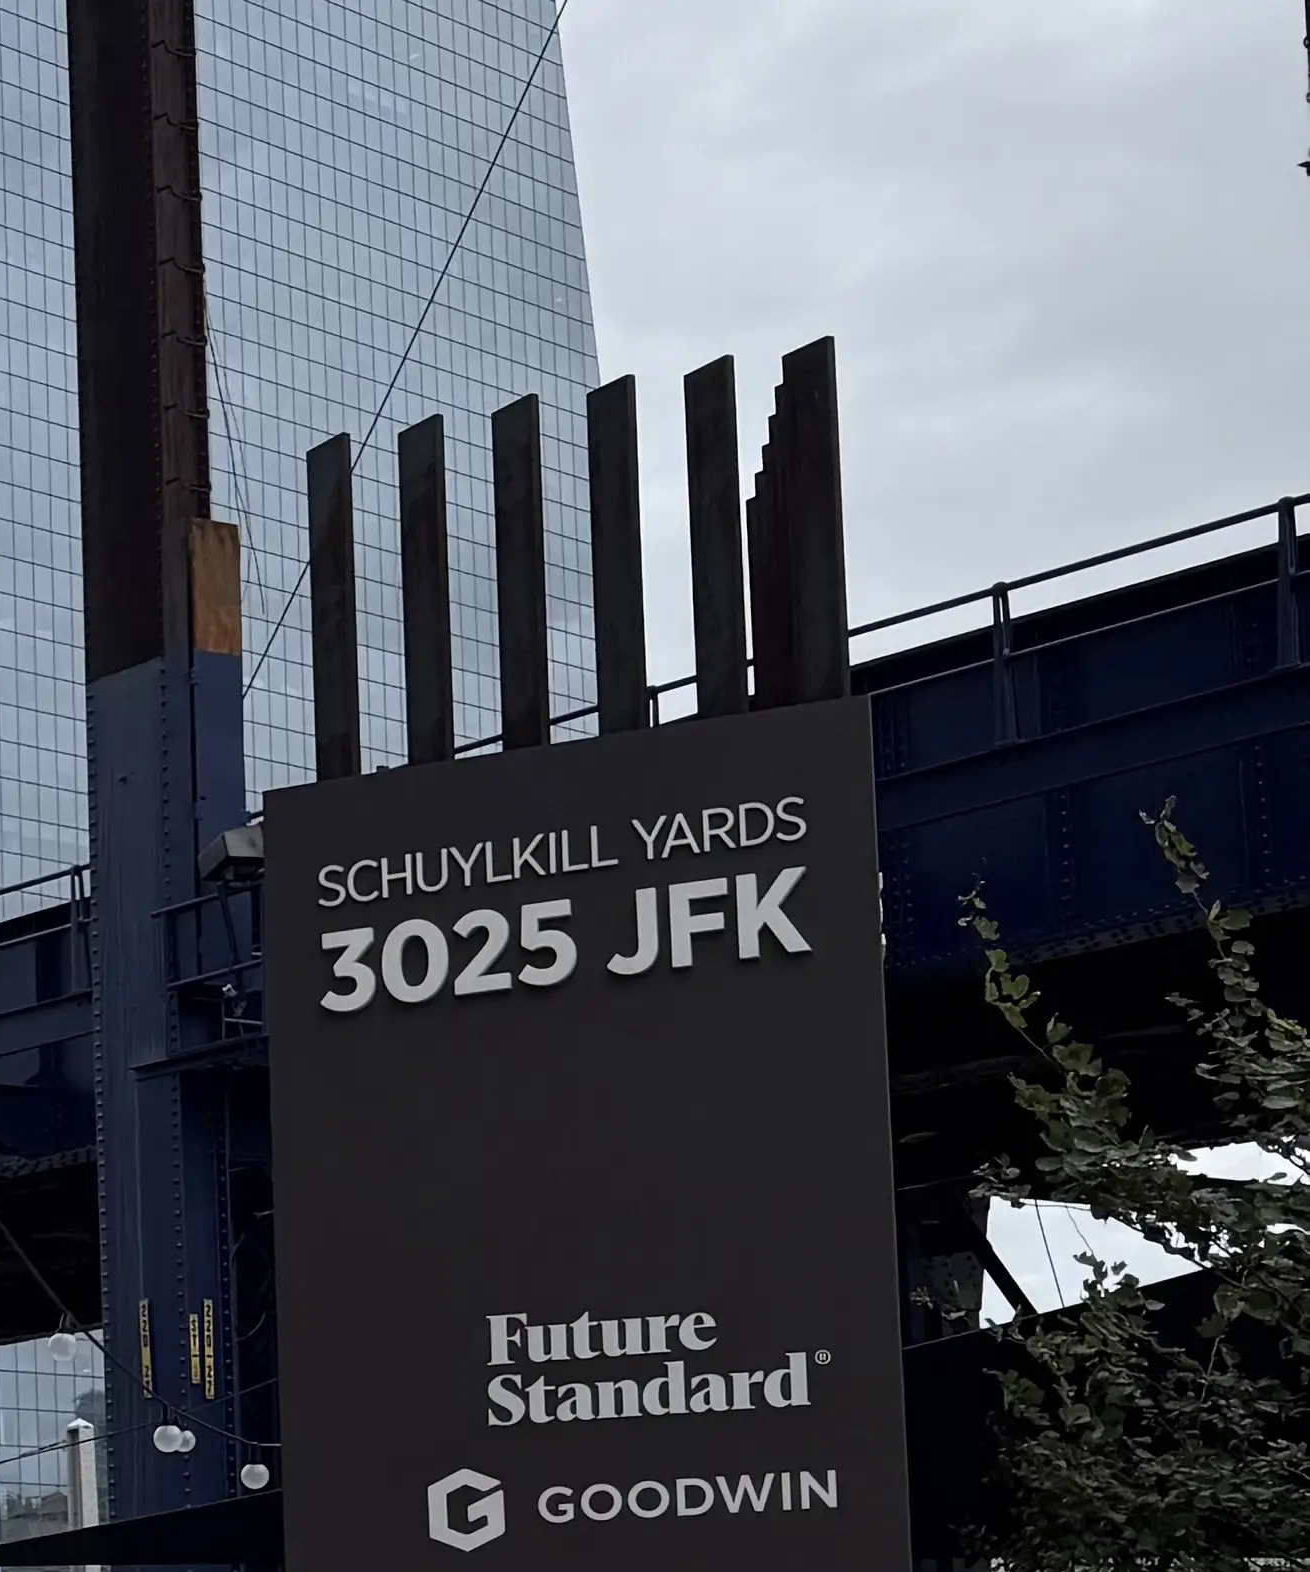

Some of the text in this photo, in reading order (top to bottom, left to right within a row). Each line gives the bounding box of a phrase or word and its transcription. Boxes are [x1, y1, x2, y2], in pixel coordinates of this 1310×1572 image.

[318, 796, 807, 907] SCHUYLKILL YARDS
[319, 865, 813, 1012] 3025 JFK
[485, 1311, 717, 1366] Future
[537, 1469, 838, 1524] GOODWIN
